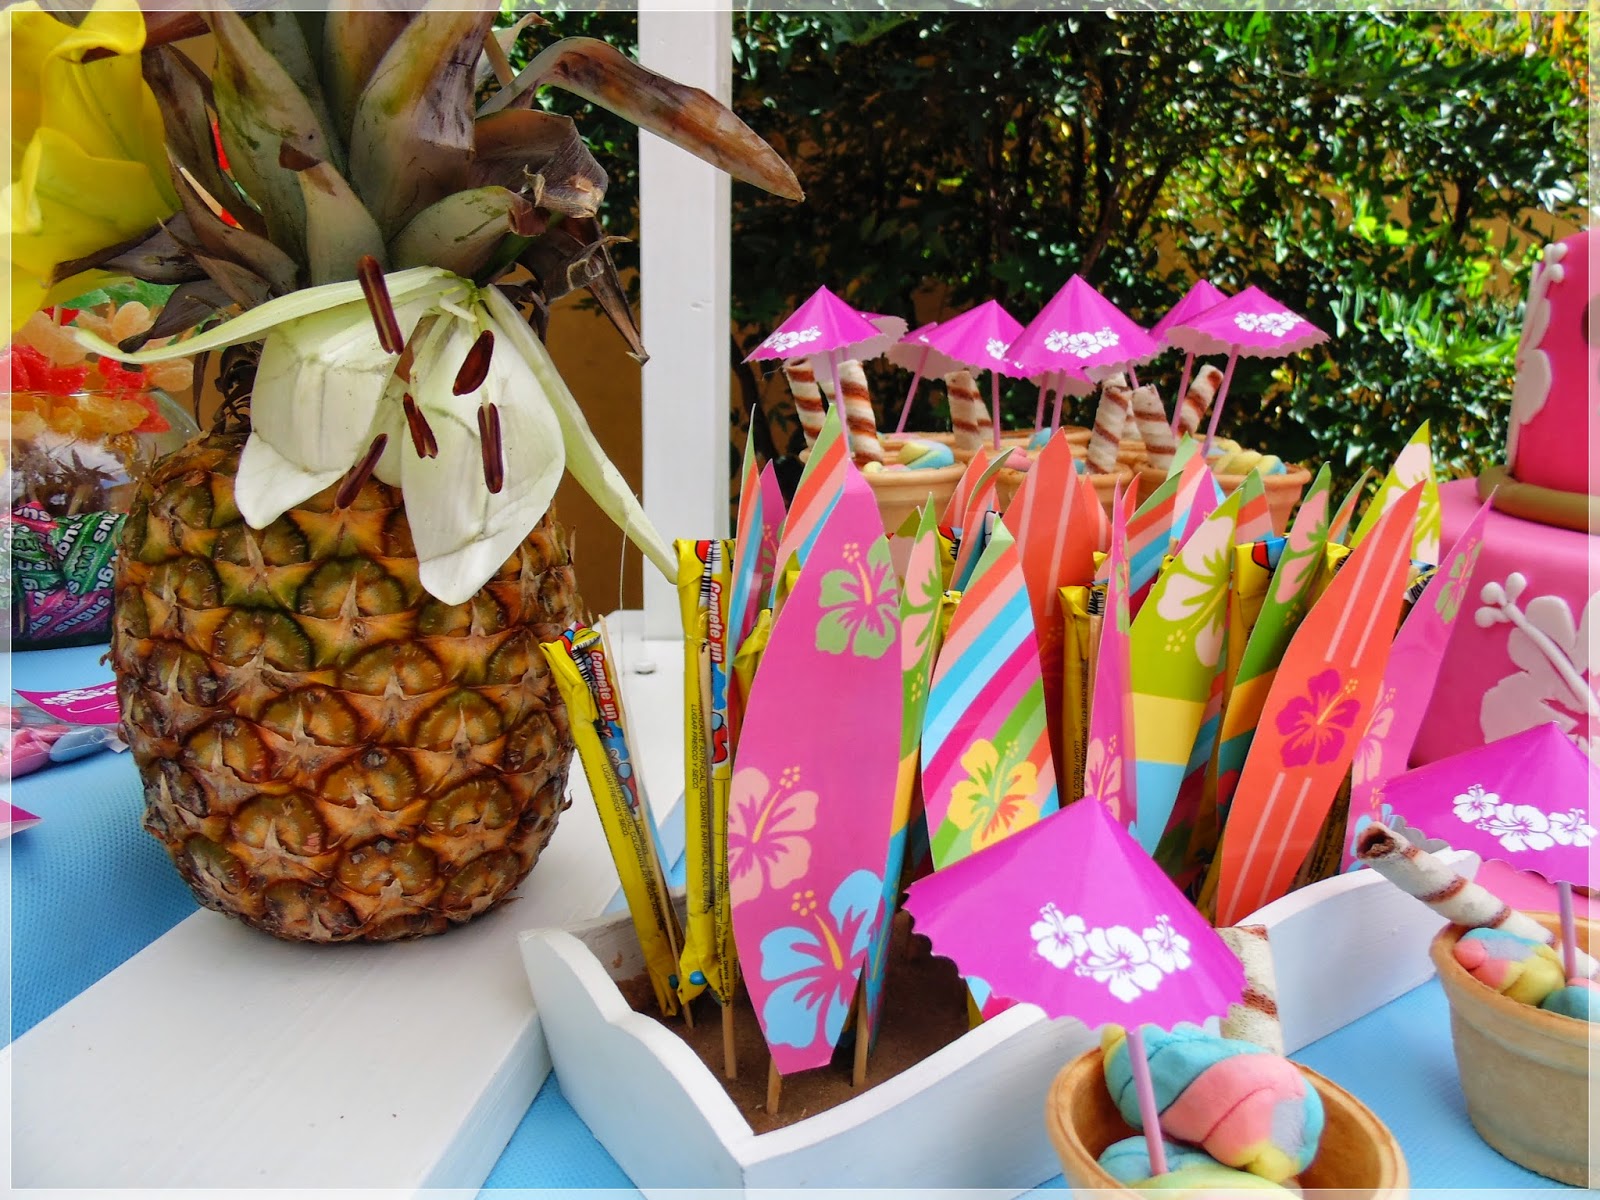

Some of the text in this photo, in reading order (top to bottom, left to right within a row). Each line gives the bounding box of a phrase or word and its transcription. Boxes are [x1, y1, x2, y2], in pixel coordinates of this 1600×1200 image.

[53, 595, 112, 634] sugus
[709, 581, 724, 662] Comete un
[590, 651, 618, 720] Comete un
[690, 703, 698, 731] LUGAR
[691, 732, 699, 761] FRESCO
[700, 786, 708, 829] COLORANTE
